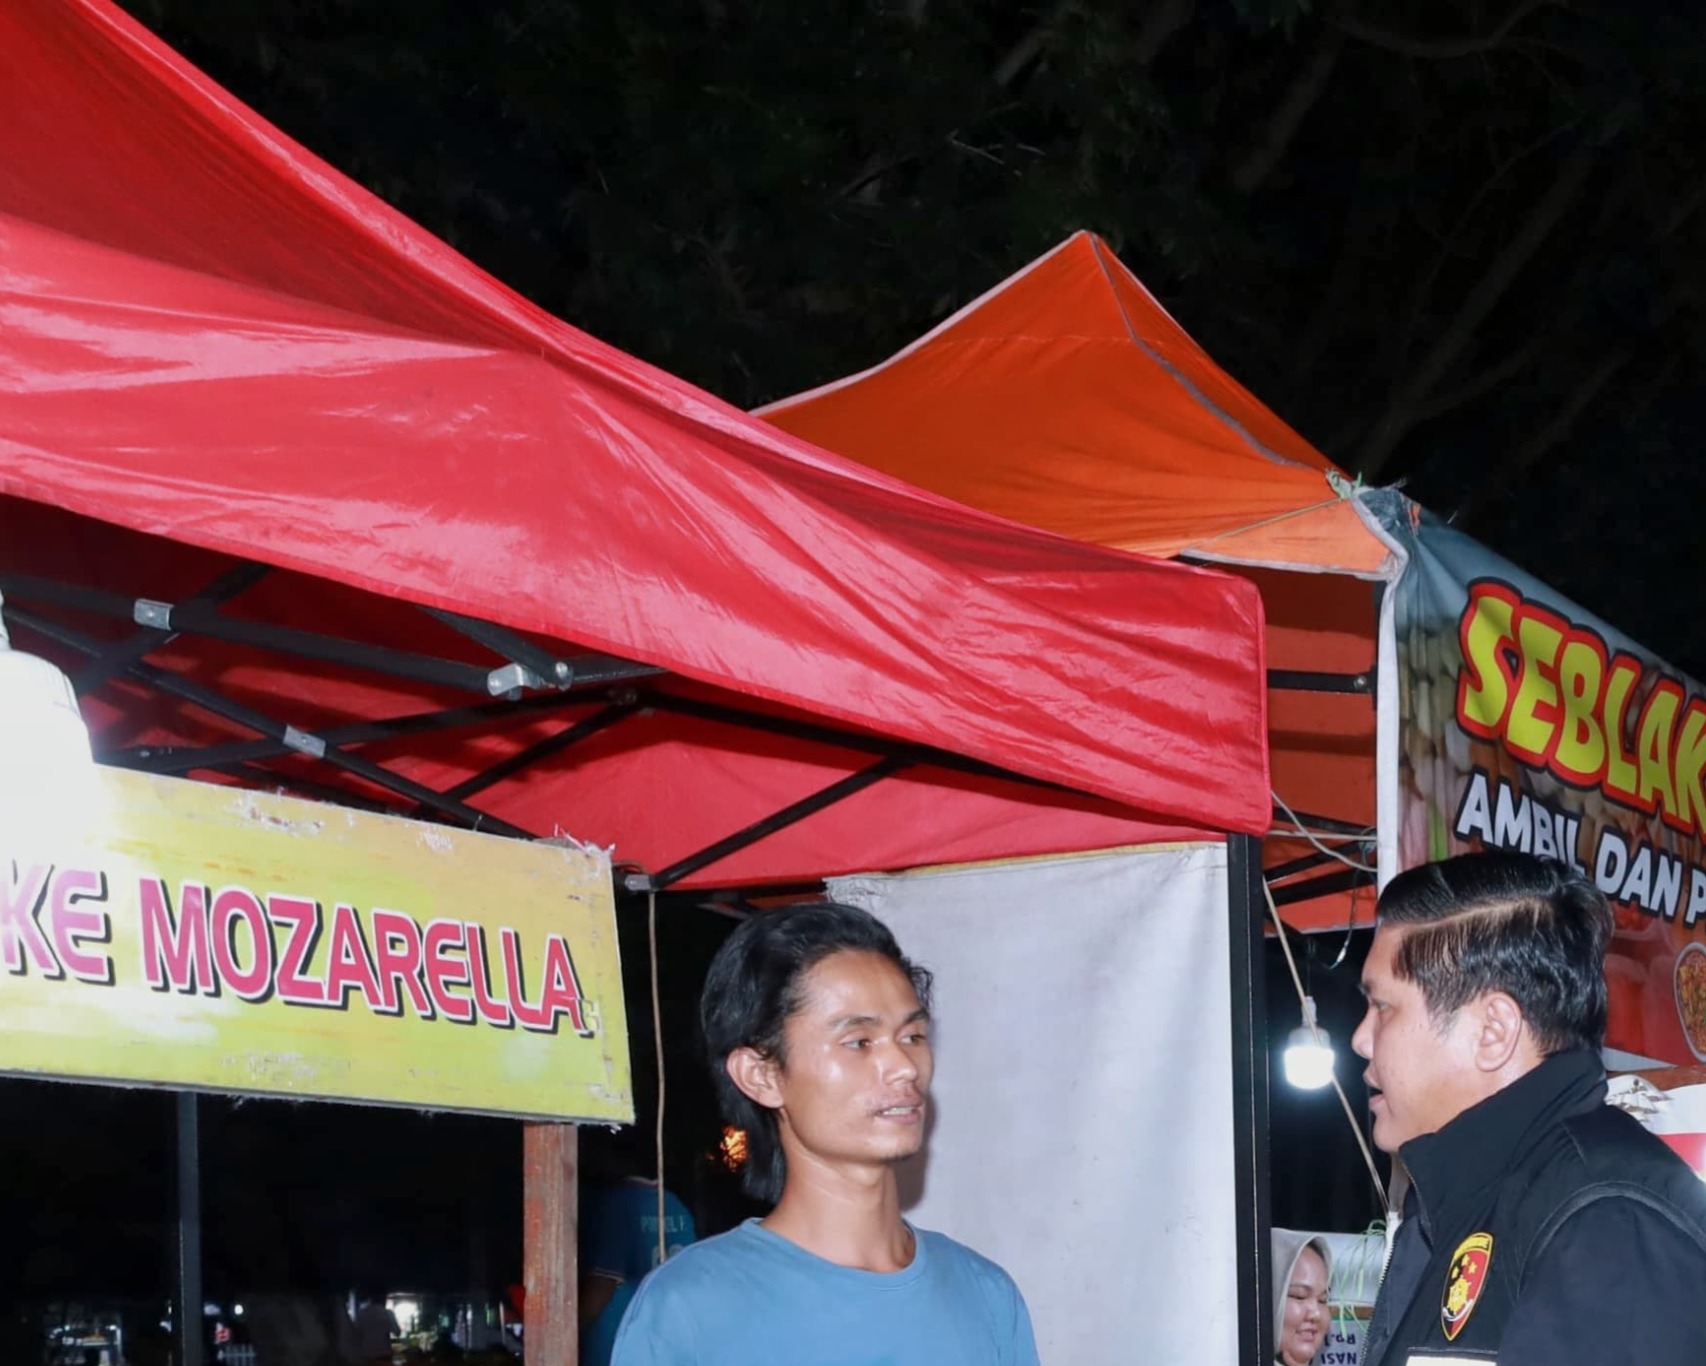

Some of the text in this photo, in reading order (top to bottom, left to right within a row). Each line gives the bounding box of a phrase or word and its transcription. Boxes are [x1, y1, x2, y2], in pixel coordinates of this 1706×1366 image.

[1456, 770, 1586, 876] AMBIL
[1595, 831, 1682, 918] DAN
[0, 860, 597, 1037] KE MOZARELLA
[1321, 1352, 1357, 1365] NASI
